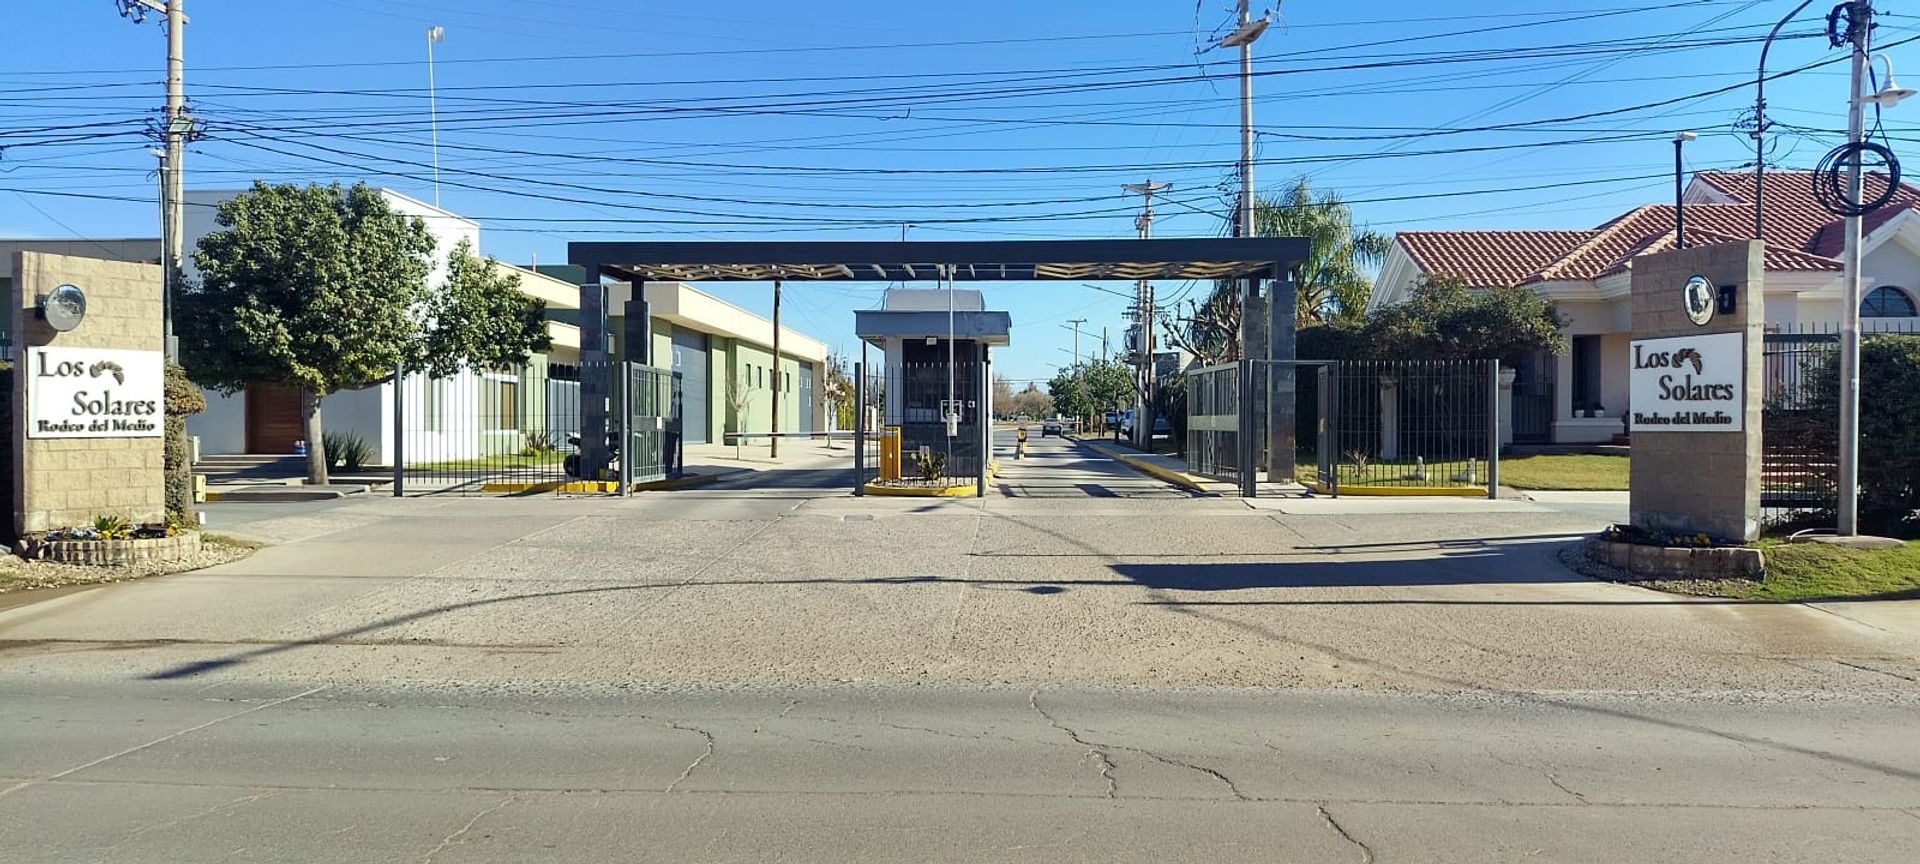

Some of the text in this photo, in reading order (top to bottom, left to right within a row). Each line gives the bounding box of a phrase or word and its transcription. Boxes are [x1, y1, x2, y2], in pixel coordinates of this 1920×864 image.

[37, 351, 84, 377] Los
[1634, 345, 1669, 369] Los
[1659, 374, 1734, 401] Solares
[71, 390, 156, 416] Solares
[37, 418, 155, 433] Rodeo del Medio
[1634, 410, 1732, 425] Rodeo del Medio
